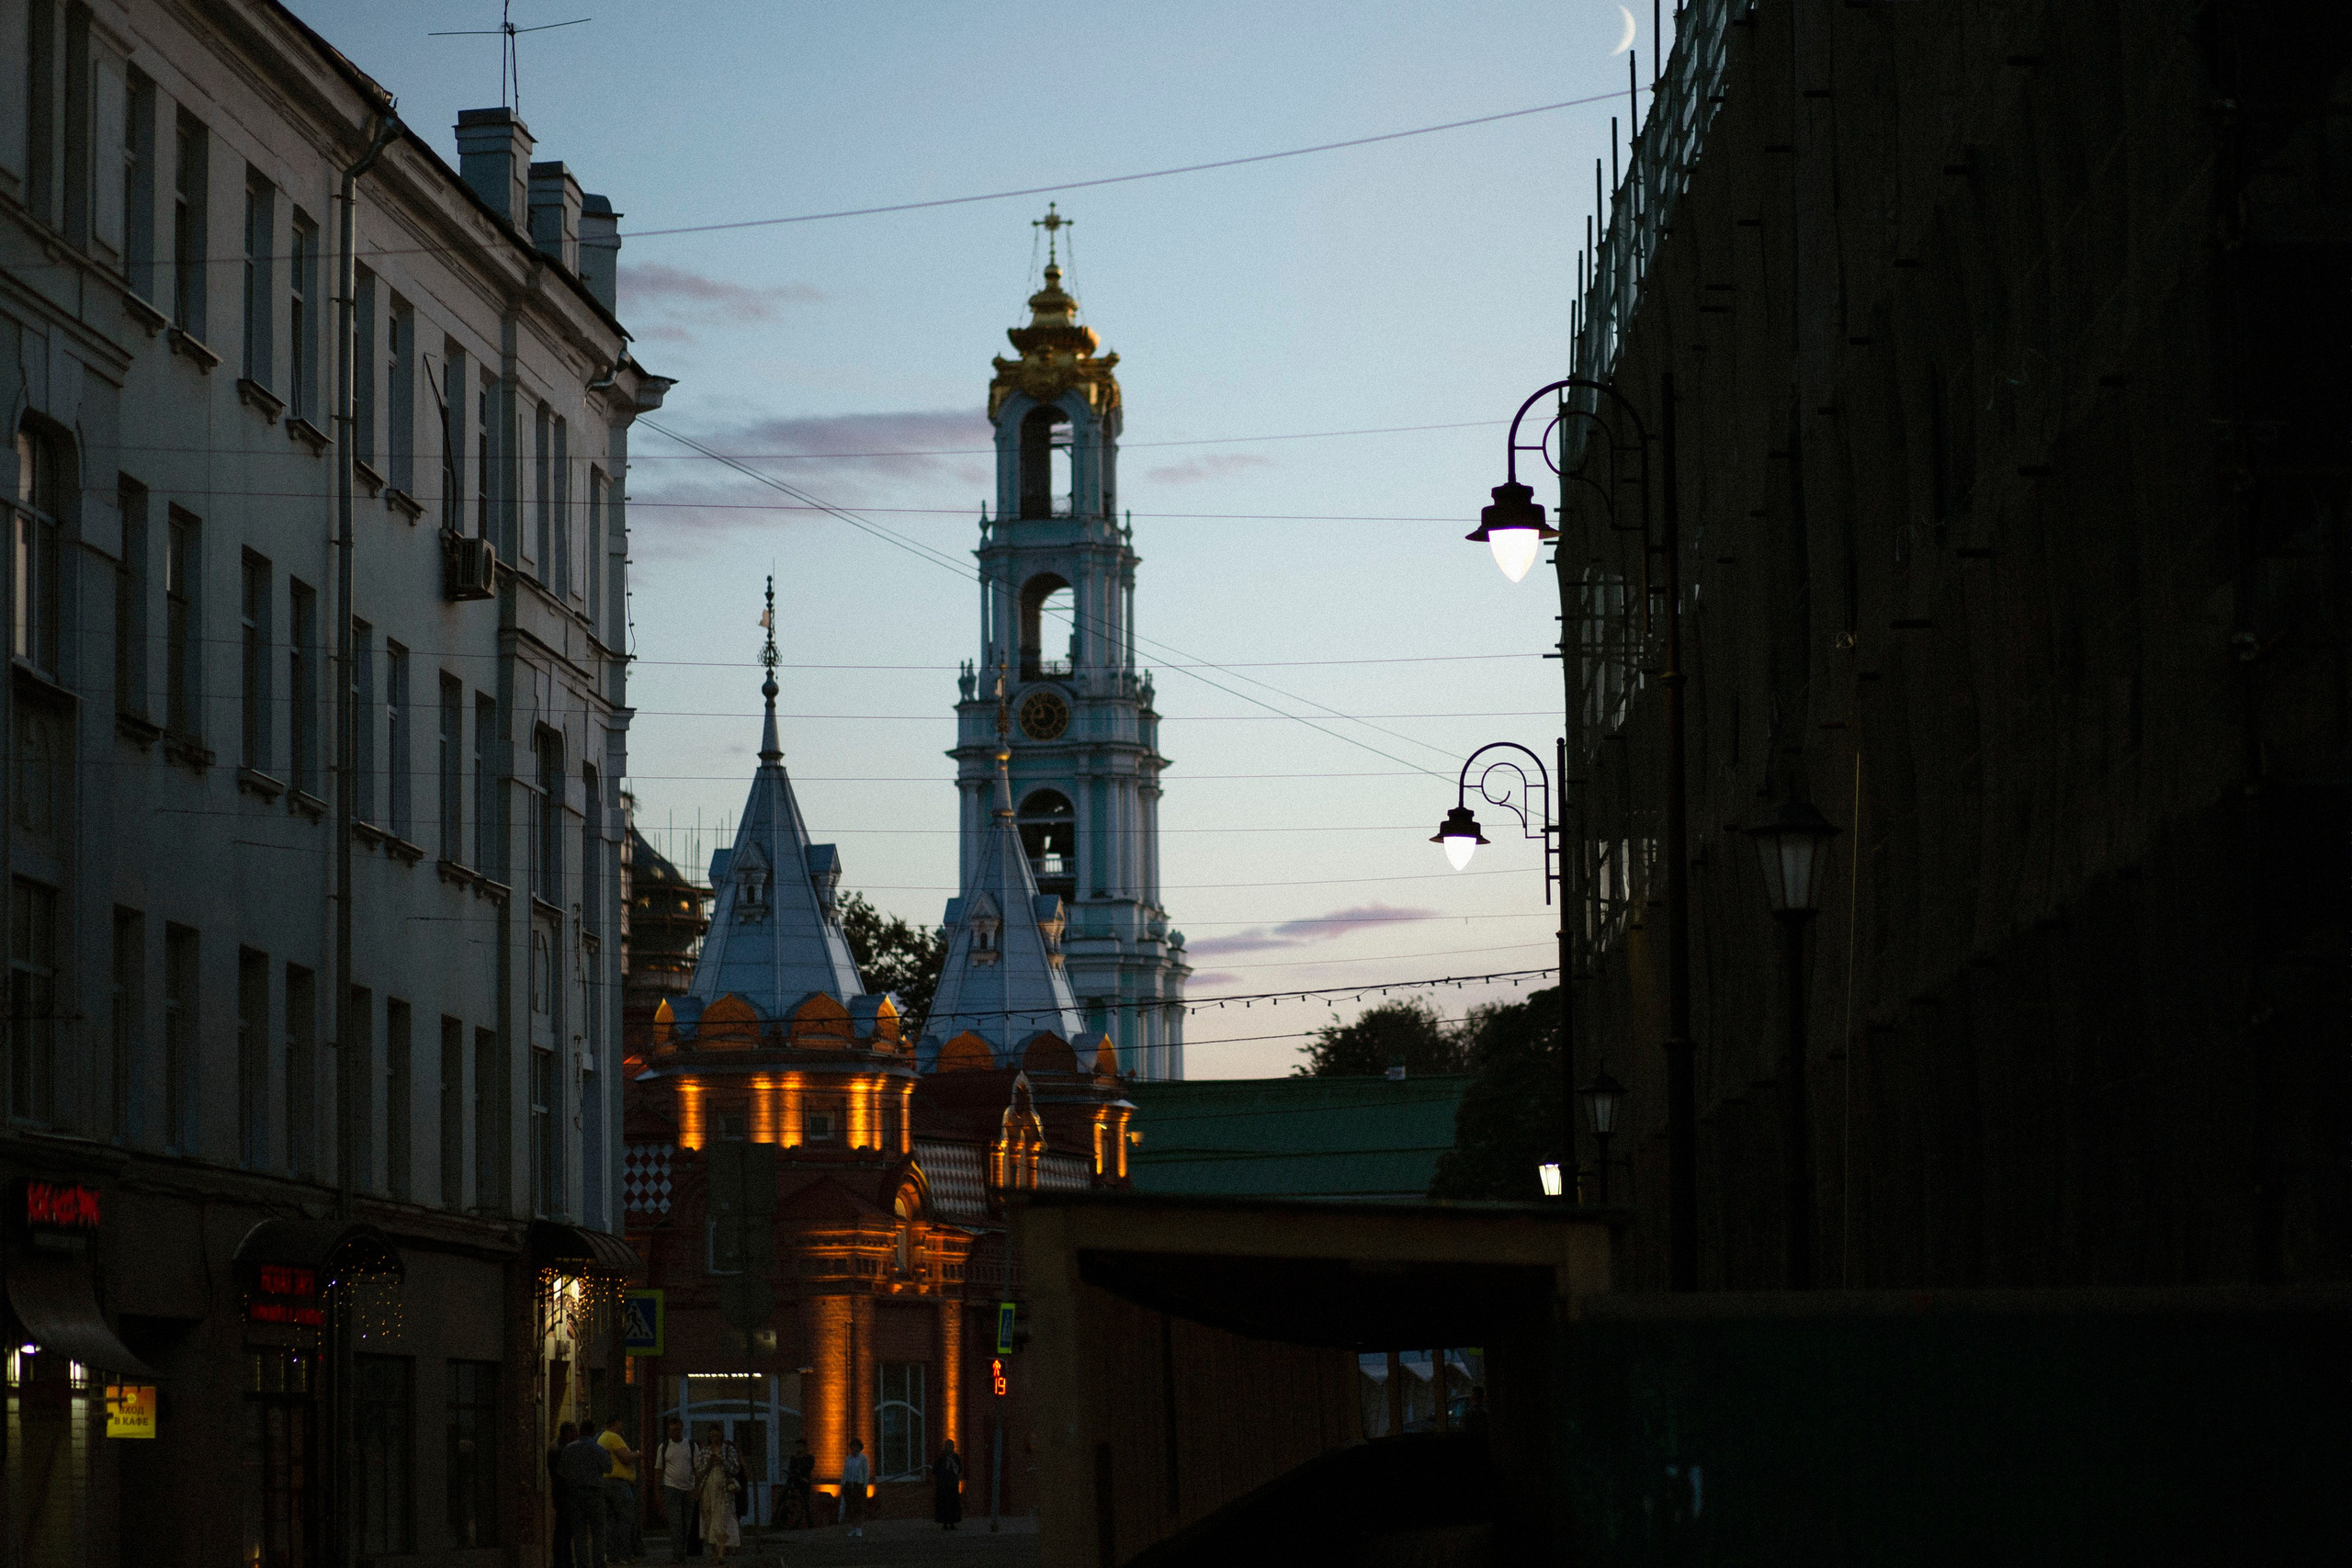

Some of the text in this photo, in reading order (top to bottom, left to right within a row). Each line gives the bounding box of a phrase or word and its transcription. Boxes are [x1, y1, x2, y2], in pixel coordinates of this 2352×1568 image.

[995, 1377, 1006, 1395] 19
[119, 1406, 144, 1416] ВХОД
[114, 1417, 149, 1426] В КАФЕ
